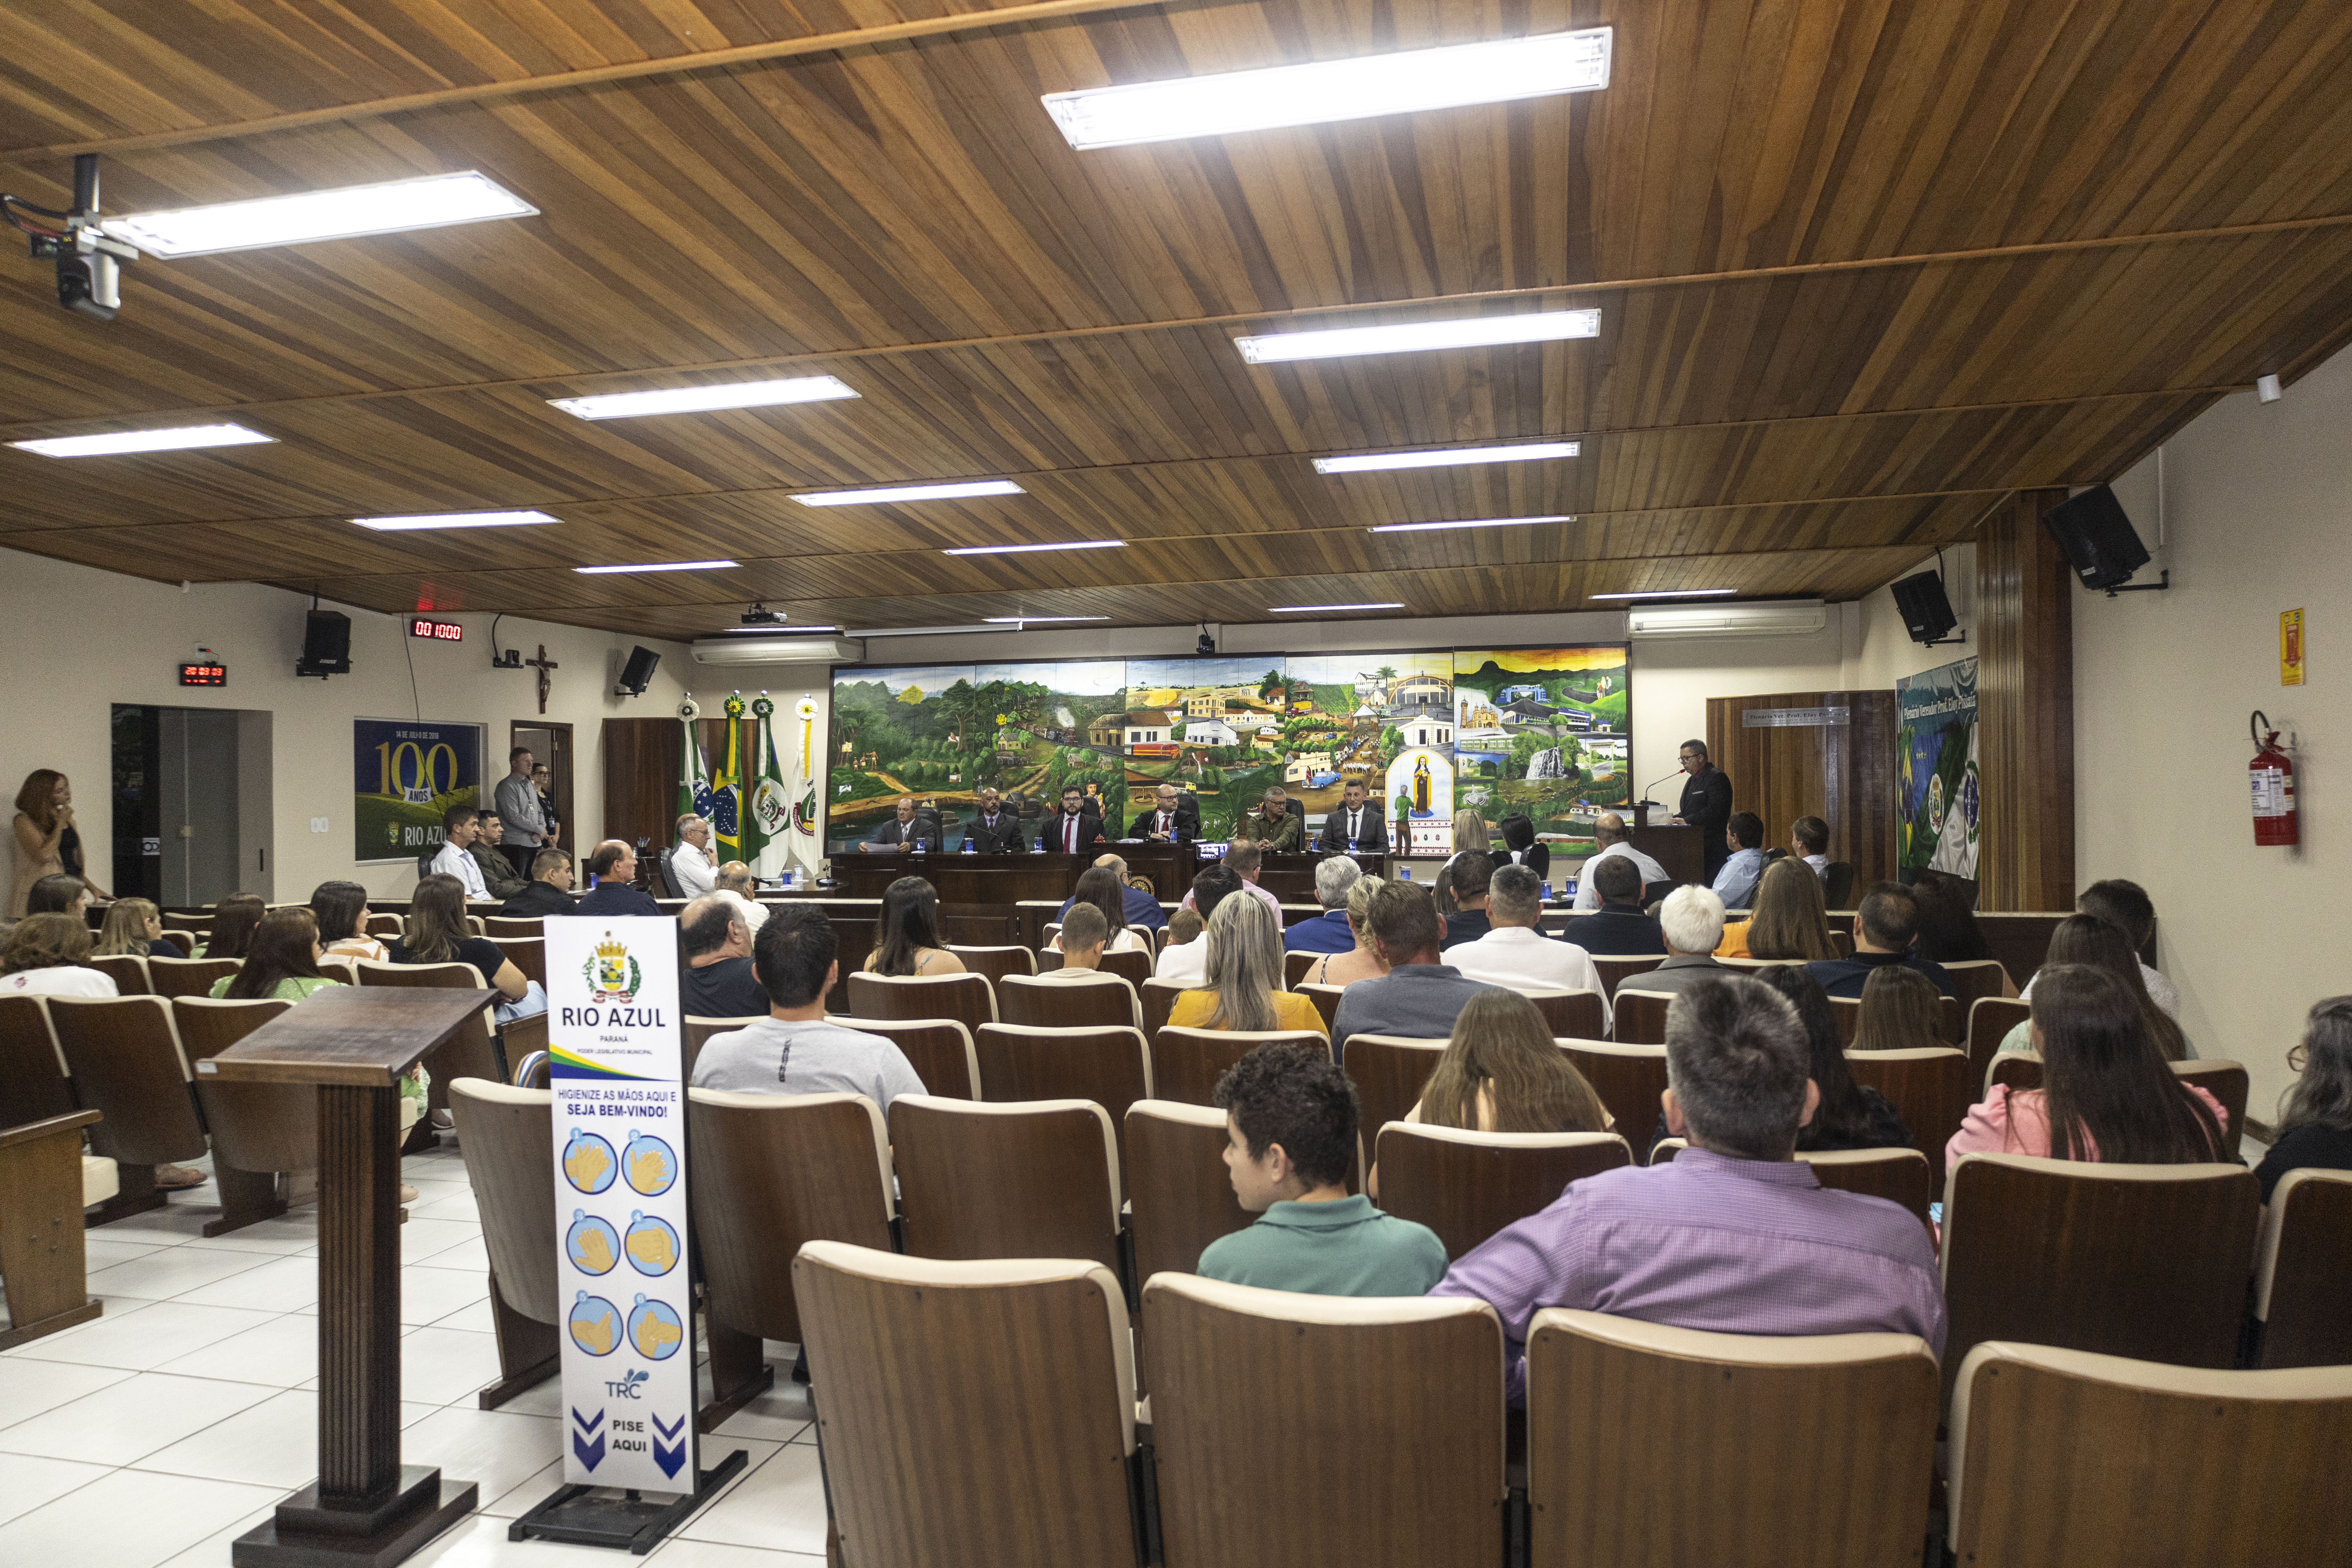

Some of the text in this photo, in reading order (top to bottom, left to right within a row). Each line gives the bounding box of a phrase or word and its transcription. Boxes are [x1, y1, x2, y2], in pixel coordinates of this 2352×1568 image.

[416, 621, 461, 640] 00 1000
[376, 741, 458, 795] 100
[408, 790, 428, 802] ANOS
[405, 825, 447, 846] RIO AZU
[562, 1008, 666, 1027] RIO AZUL
[558, 1088, 677, 1102] HIGIENIZE AS MÃOS AQUI E
[567, 1104, 668, 1117] SEJA BEM-VINDO!
[574, 1130, 638, 1141] 1 2
[576, 1211, 641, 1222] 3 4
[637, 1294, 644, 1304] 6
[605, 1381, 641, 1400] TRC
[612, 1420, 644, 1432] PISE
[612, 1439, 647, 1452] AQUI
